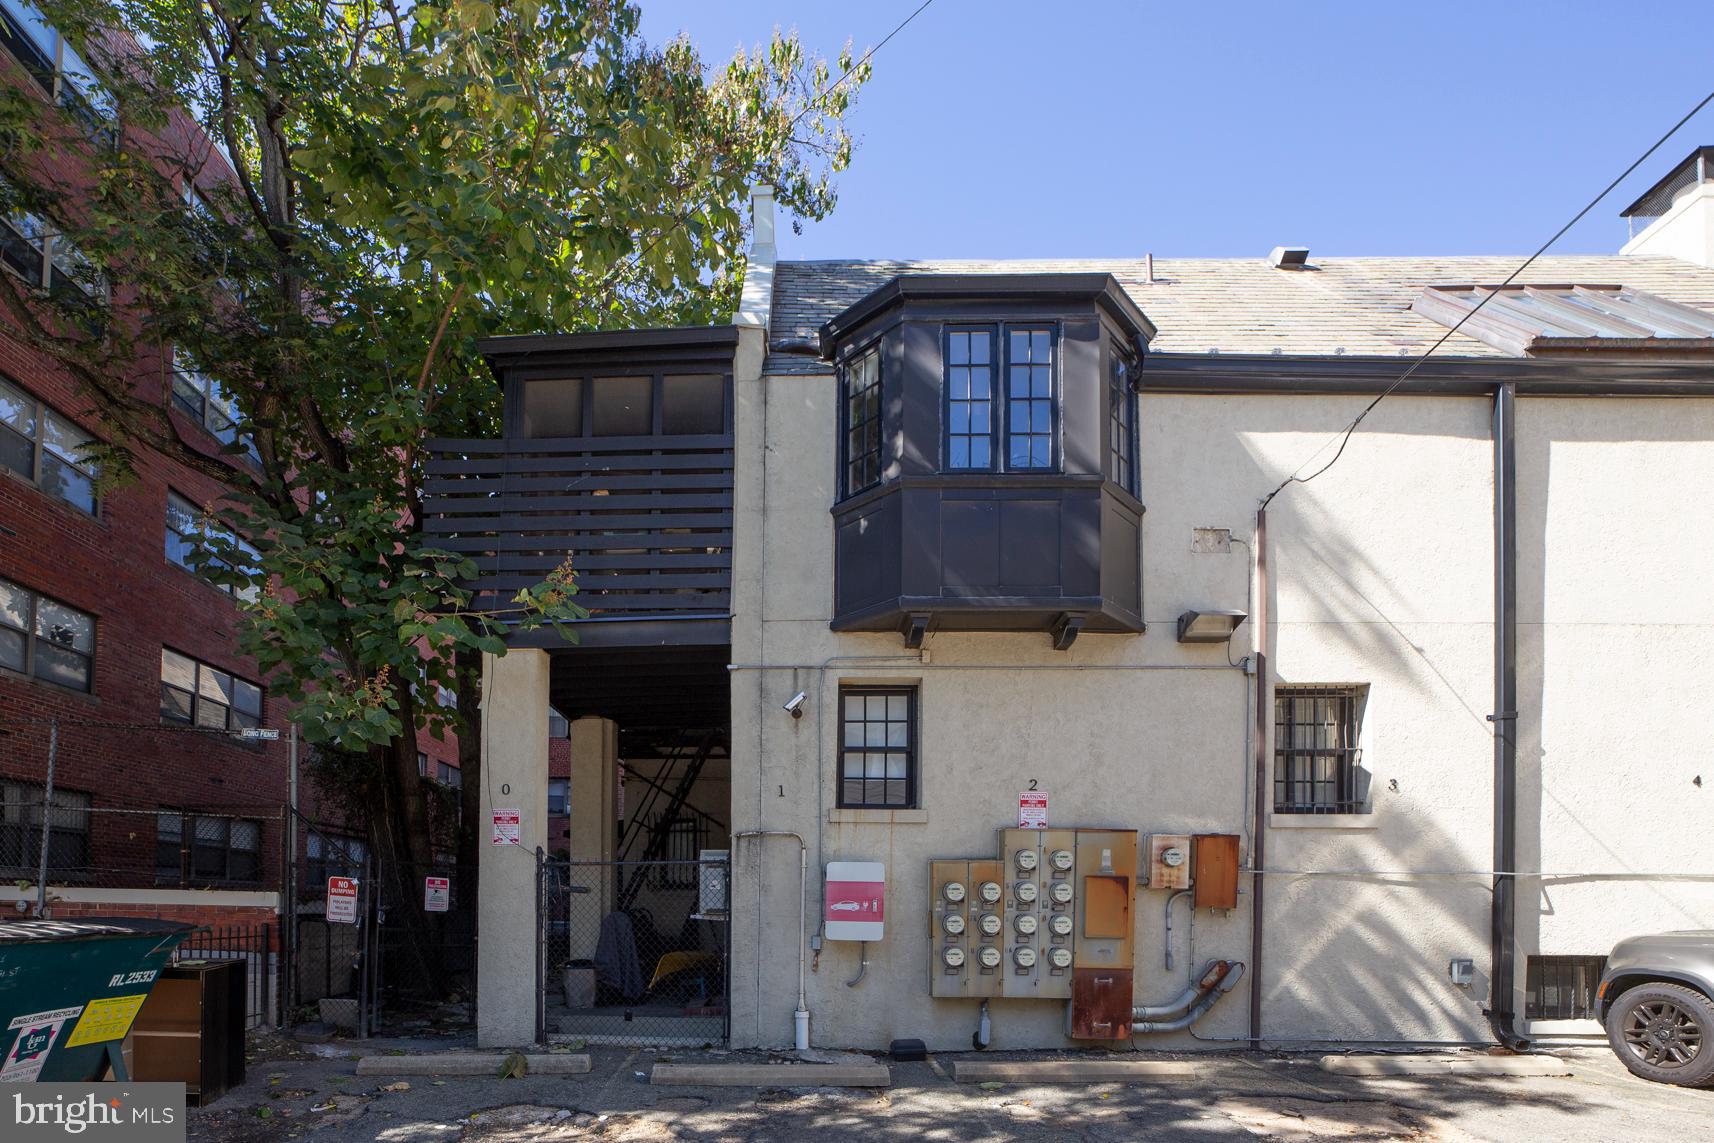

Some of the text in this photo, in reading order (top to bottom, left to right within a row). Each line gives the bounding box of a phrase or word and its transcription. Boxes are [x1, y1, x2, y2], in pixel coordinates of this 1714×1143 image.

[260, 730, 277, 738] FENCE
[1029, 779, 1038, 791] 2
[1388, 778, 1397, 791] 3
[778, 785, 785, 797] 1
[338, 880, 349, 889] NO
[330, 887, 355, 895] DUMPING
[108, 969, 158, 988] RL 2533
[12, 1008, 81, 1027] SINGLE STREAM RECYCLING
